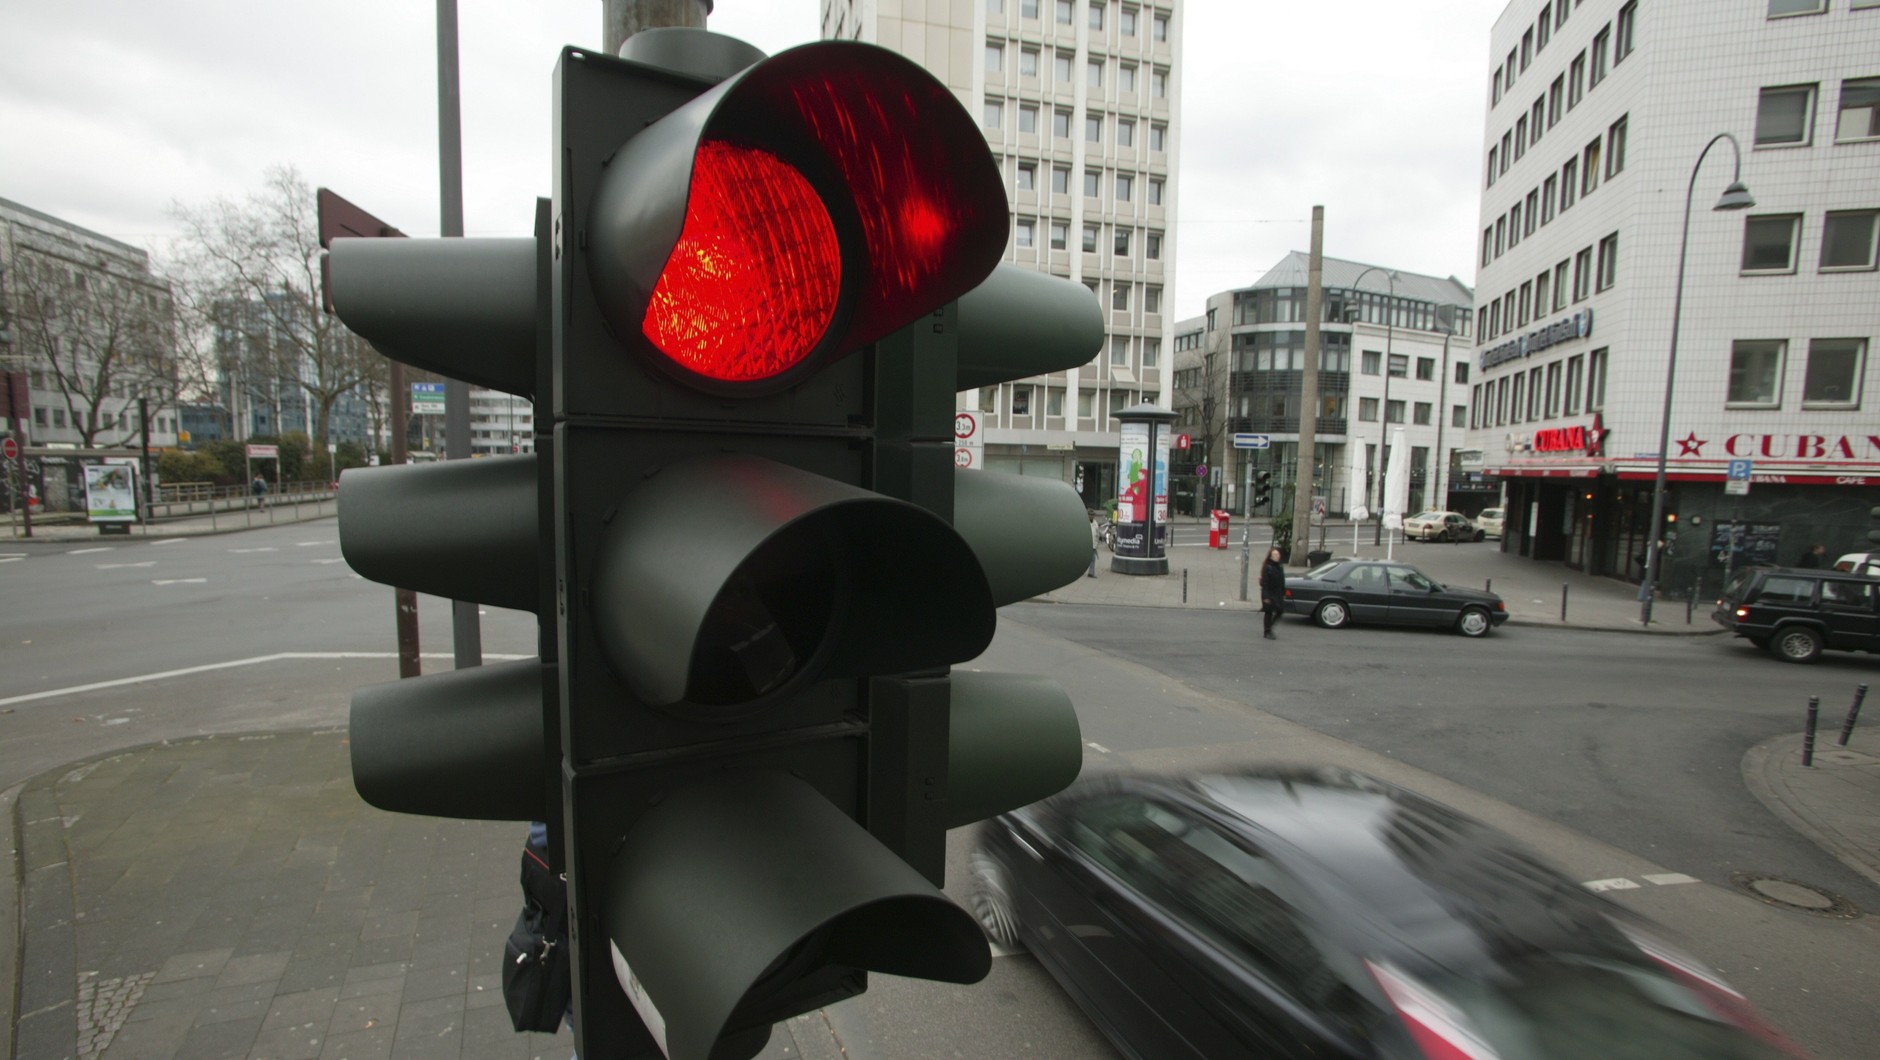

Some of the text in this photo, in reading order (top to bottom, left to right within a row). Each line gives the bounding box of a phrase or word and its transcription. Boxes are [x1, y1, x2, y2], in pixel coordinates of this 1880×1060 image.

[1535, 426, 1585, 452] CUBANA
[1732, 461, 1746, 477] P
[1744, 475, 1787, 483] UBANA
